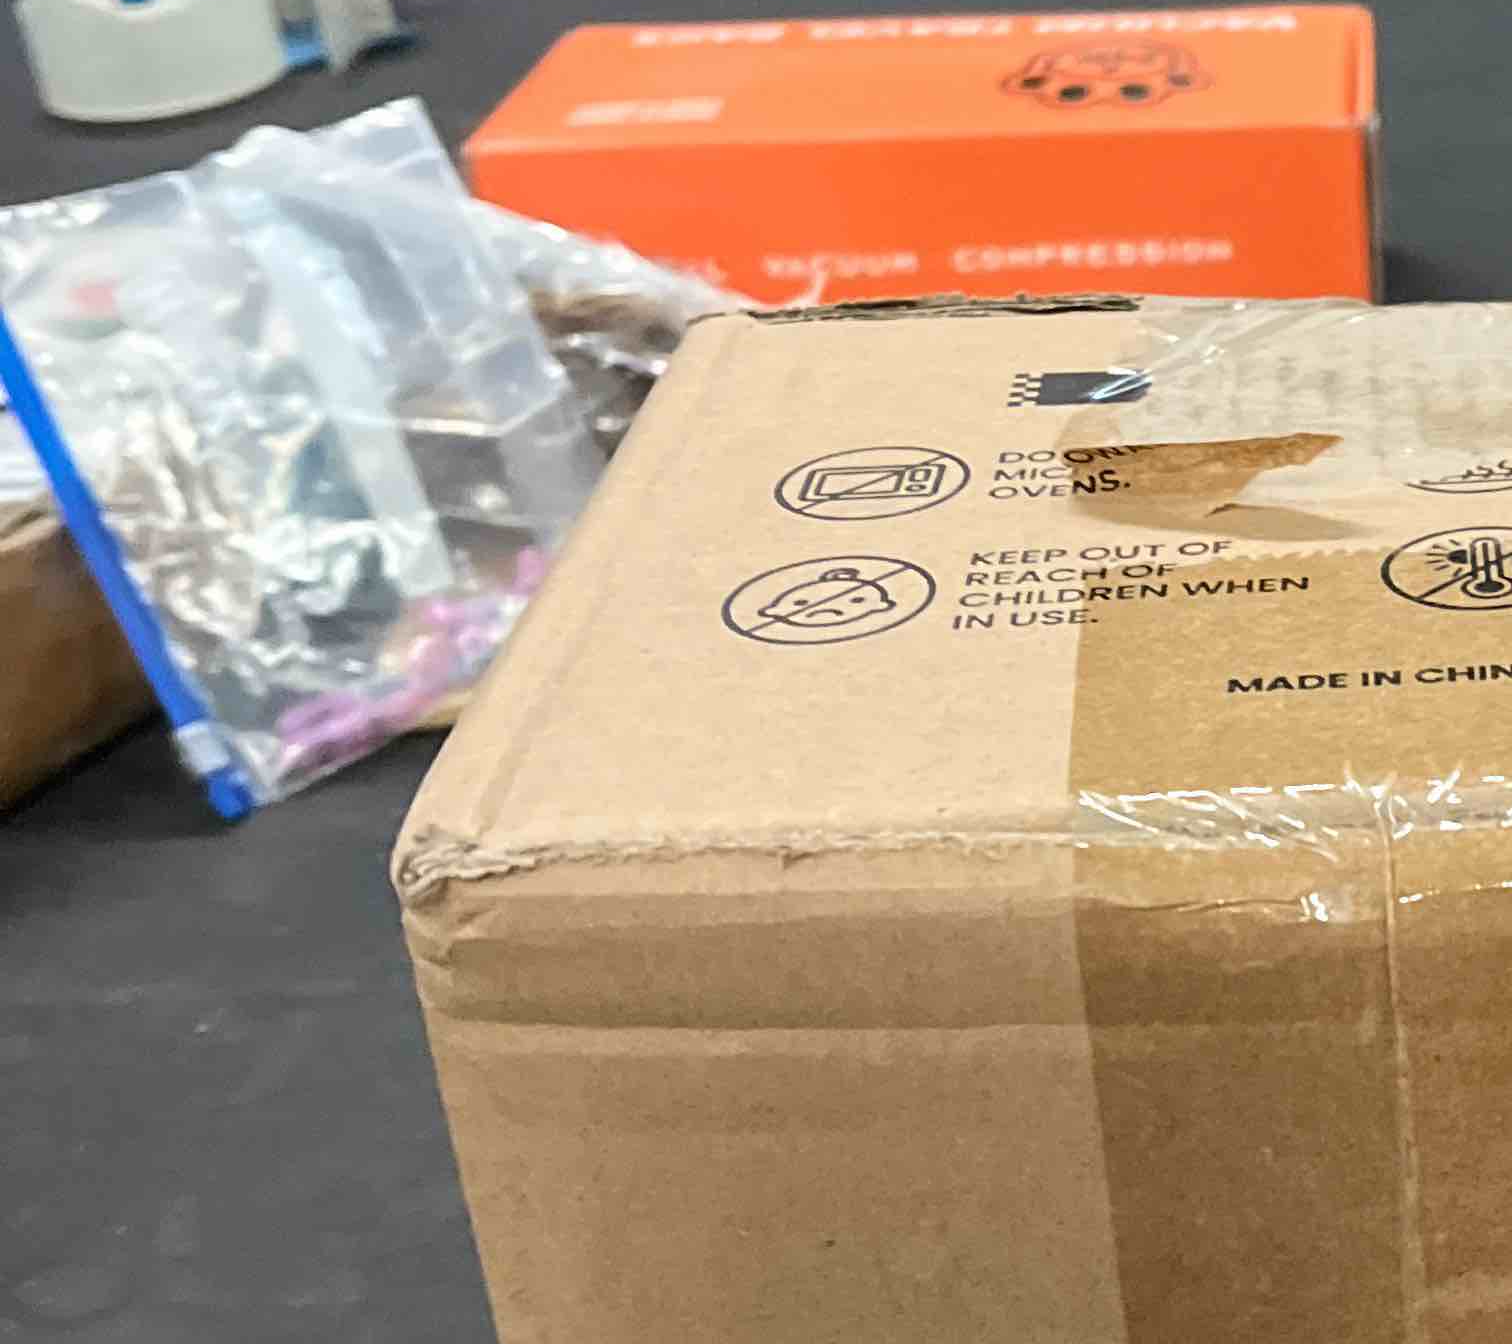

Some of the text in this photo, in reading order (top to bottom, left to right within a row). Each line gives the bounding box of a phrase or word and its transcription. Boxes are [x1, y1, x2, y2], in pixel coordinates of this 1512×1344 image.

[951, 238, 1234, 272] COMPRESSION
[988, 469, 1130, 499] OVENS.
[970, 540, 1233, 567] KEEP OUT OF
[965, 563, 1179, 587] REACH OF
[958, 576, 1311, 608] CHILDREN WHEN
[952, 608, 1099, 630] IN USE.
[1227, 672, 1349, 693] MADE
[1361, 670, 1401, 687] IN
